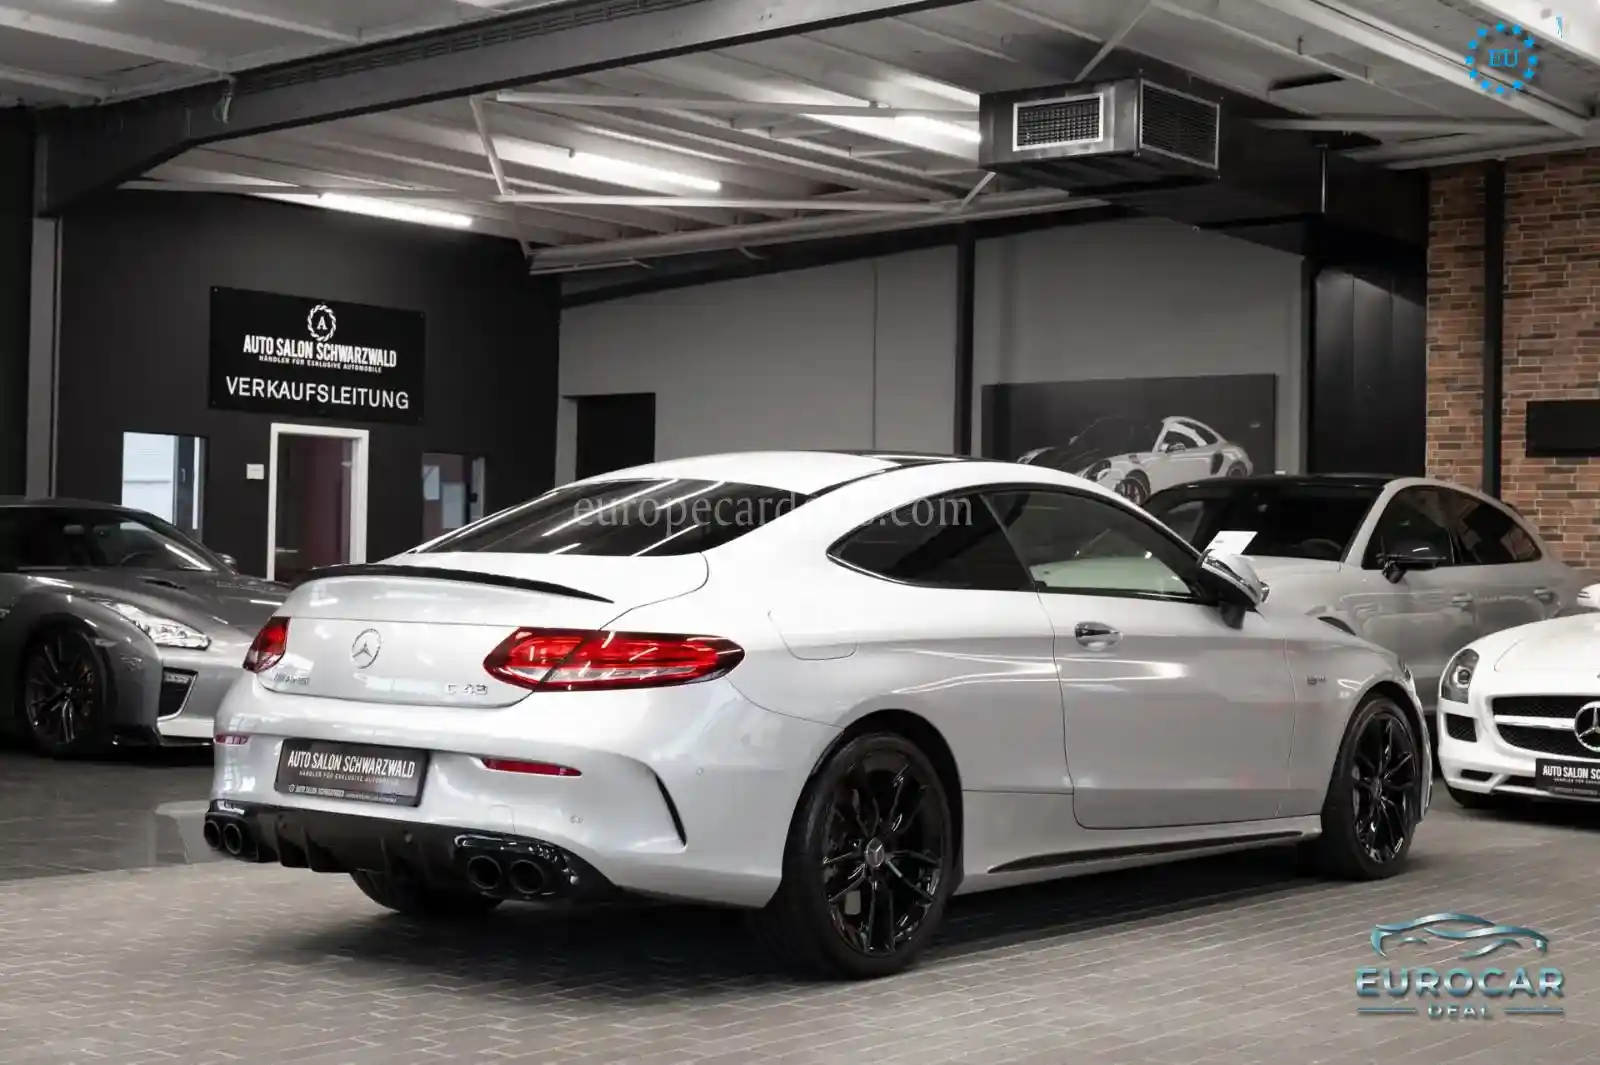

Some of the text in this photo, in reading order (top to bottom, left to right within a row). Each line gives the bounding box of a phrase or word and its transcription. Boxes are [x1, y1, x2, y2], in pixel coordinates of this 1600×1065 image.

[243, 335, 397, 367] AUTO SALON SCHWARZWALD
[226, 376, 409, 409] VERKAUFSLEITUNG
[288, 751, 415, 778] AUTO SALON SCHWARZWALD
[1542, 765, 1562, 777] AUTO
[1562, 766, 1589, 779] SALON
